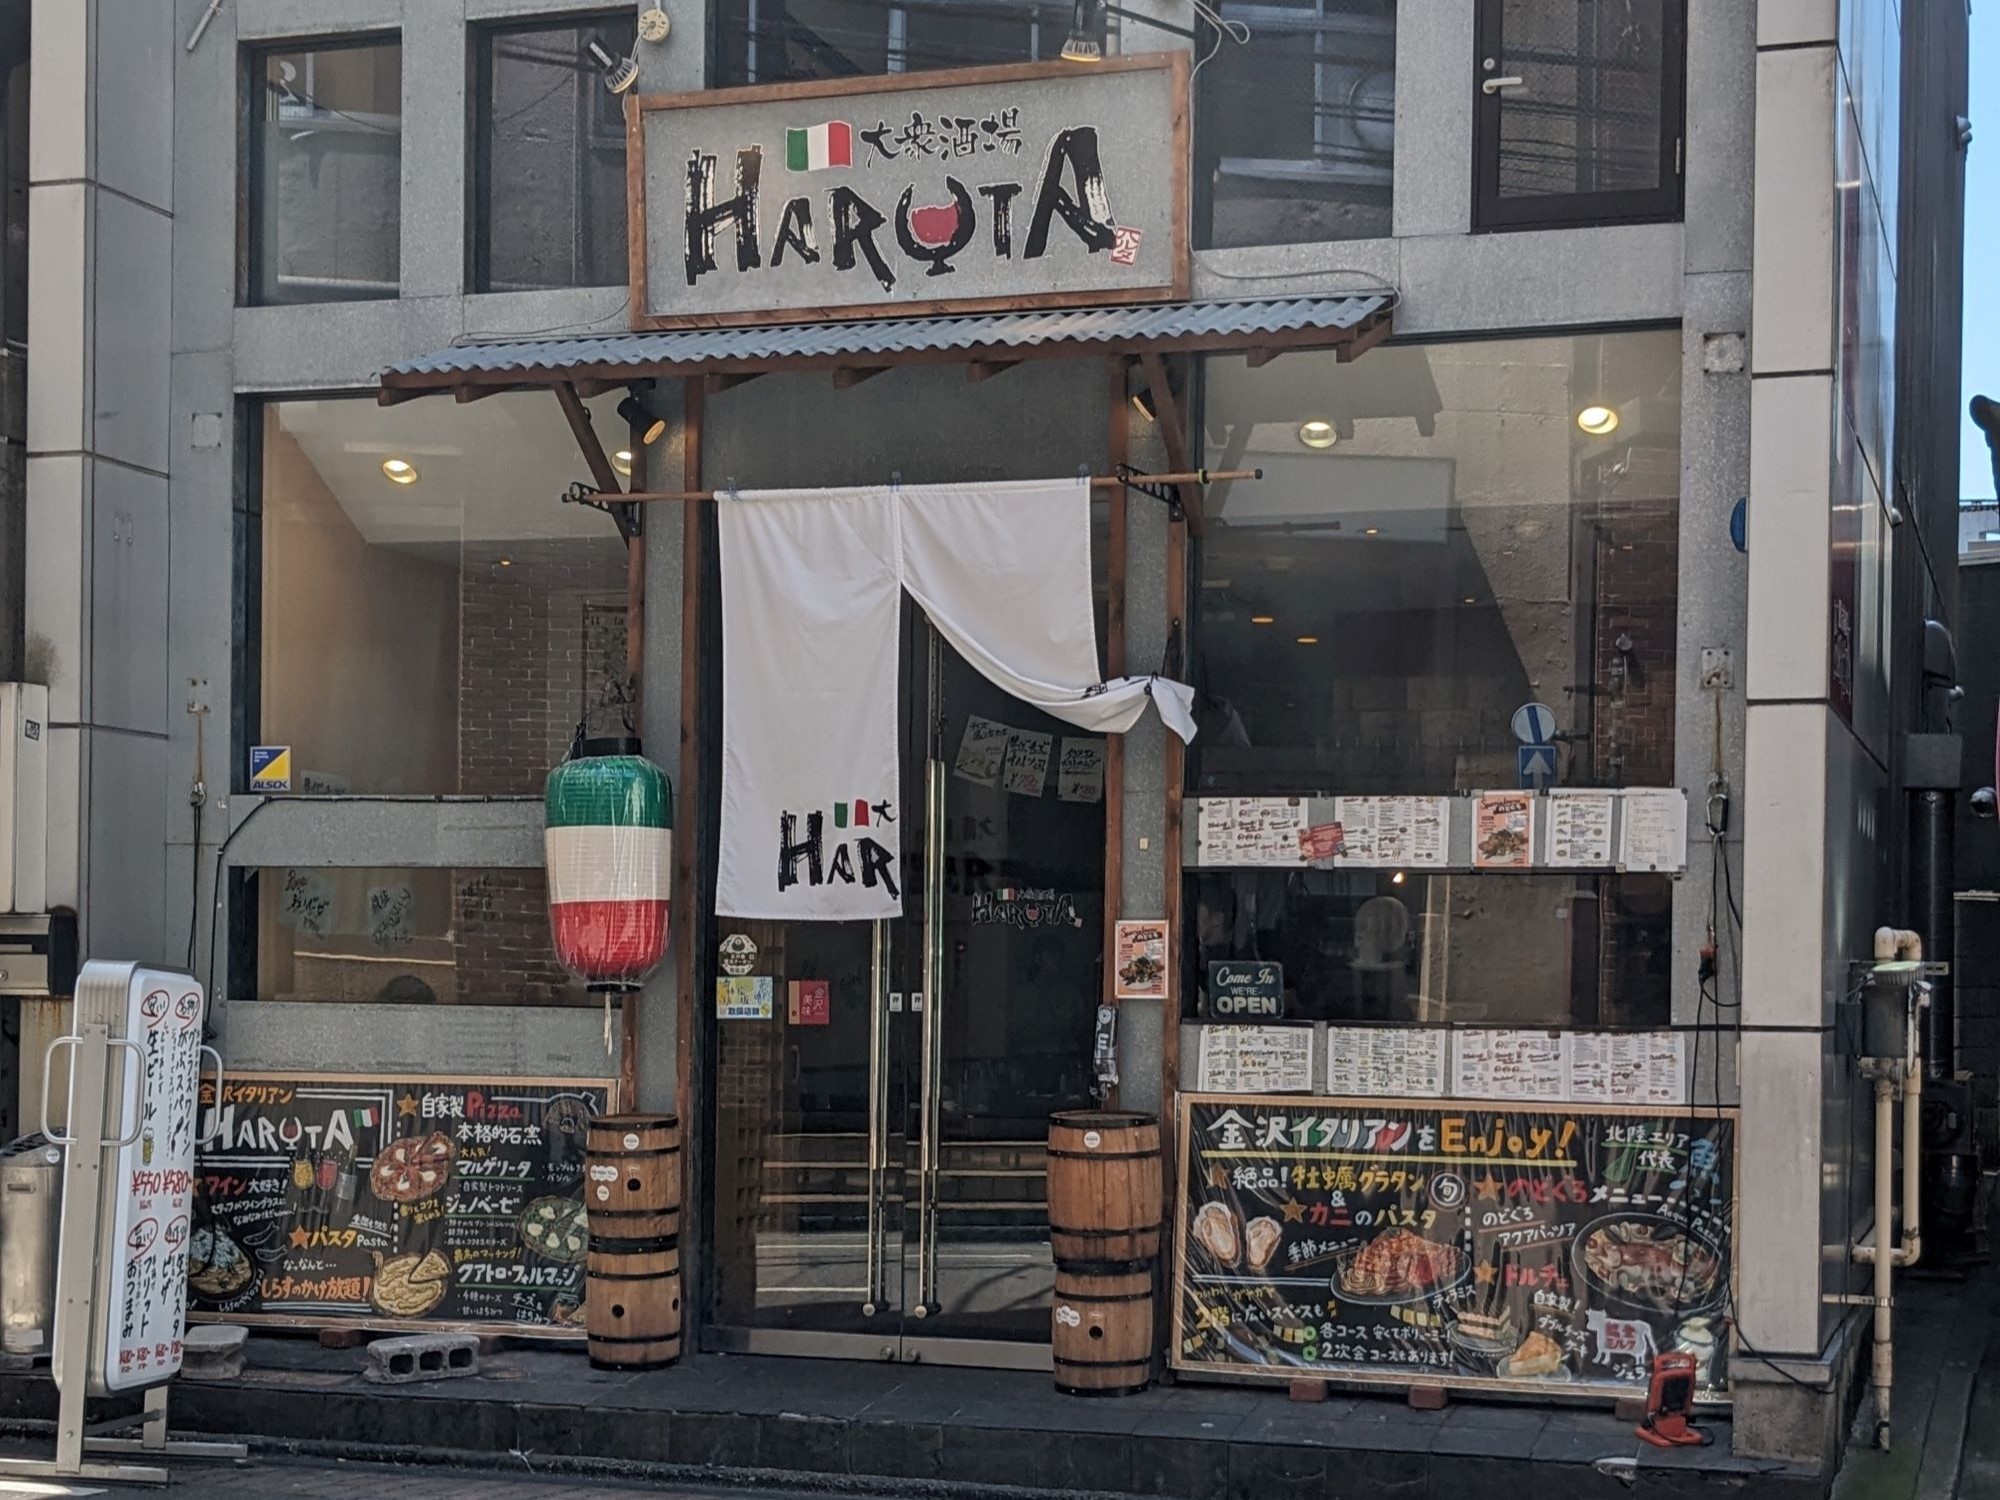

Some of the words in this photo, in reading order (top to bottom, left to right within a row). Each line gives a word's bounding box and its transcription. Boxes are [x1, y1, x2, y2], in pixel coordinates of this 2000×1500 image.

[860, 107, 1022, 168] 大衆酒場
[684, 126, 1117, 293] HARUTA
[253, 780, 288, 789] ALSOK
[871, 799, 897, 827] 大
[778, 810, 900, 901] HAR
[1216, 967, 1252, 987] Come
[1257, 967, 1275, 985] In
[1216, 997, 1277, 1014] OPEN
[144, 1028, 159, 1121] 生ビール
[455, 1157, 532, 1178] マルゲリータ
[1638, 1150, 1675, 1170] 代表
[310, 1225, 358, 1248] パスタ
[356, 1234, 389, 1248] Pasta
